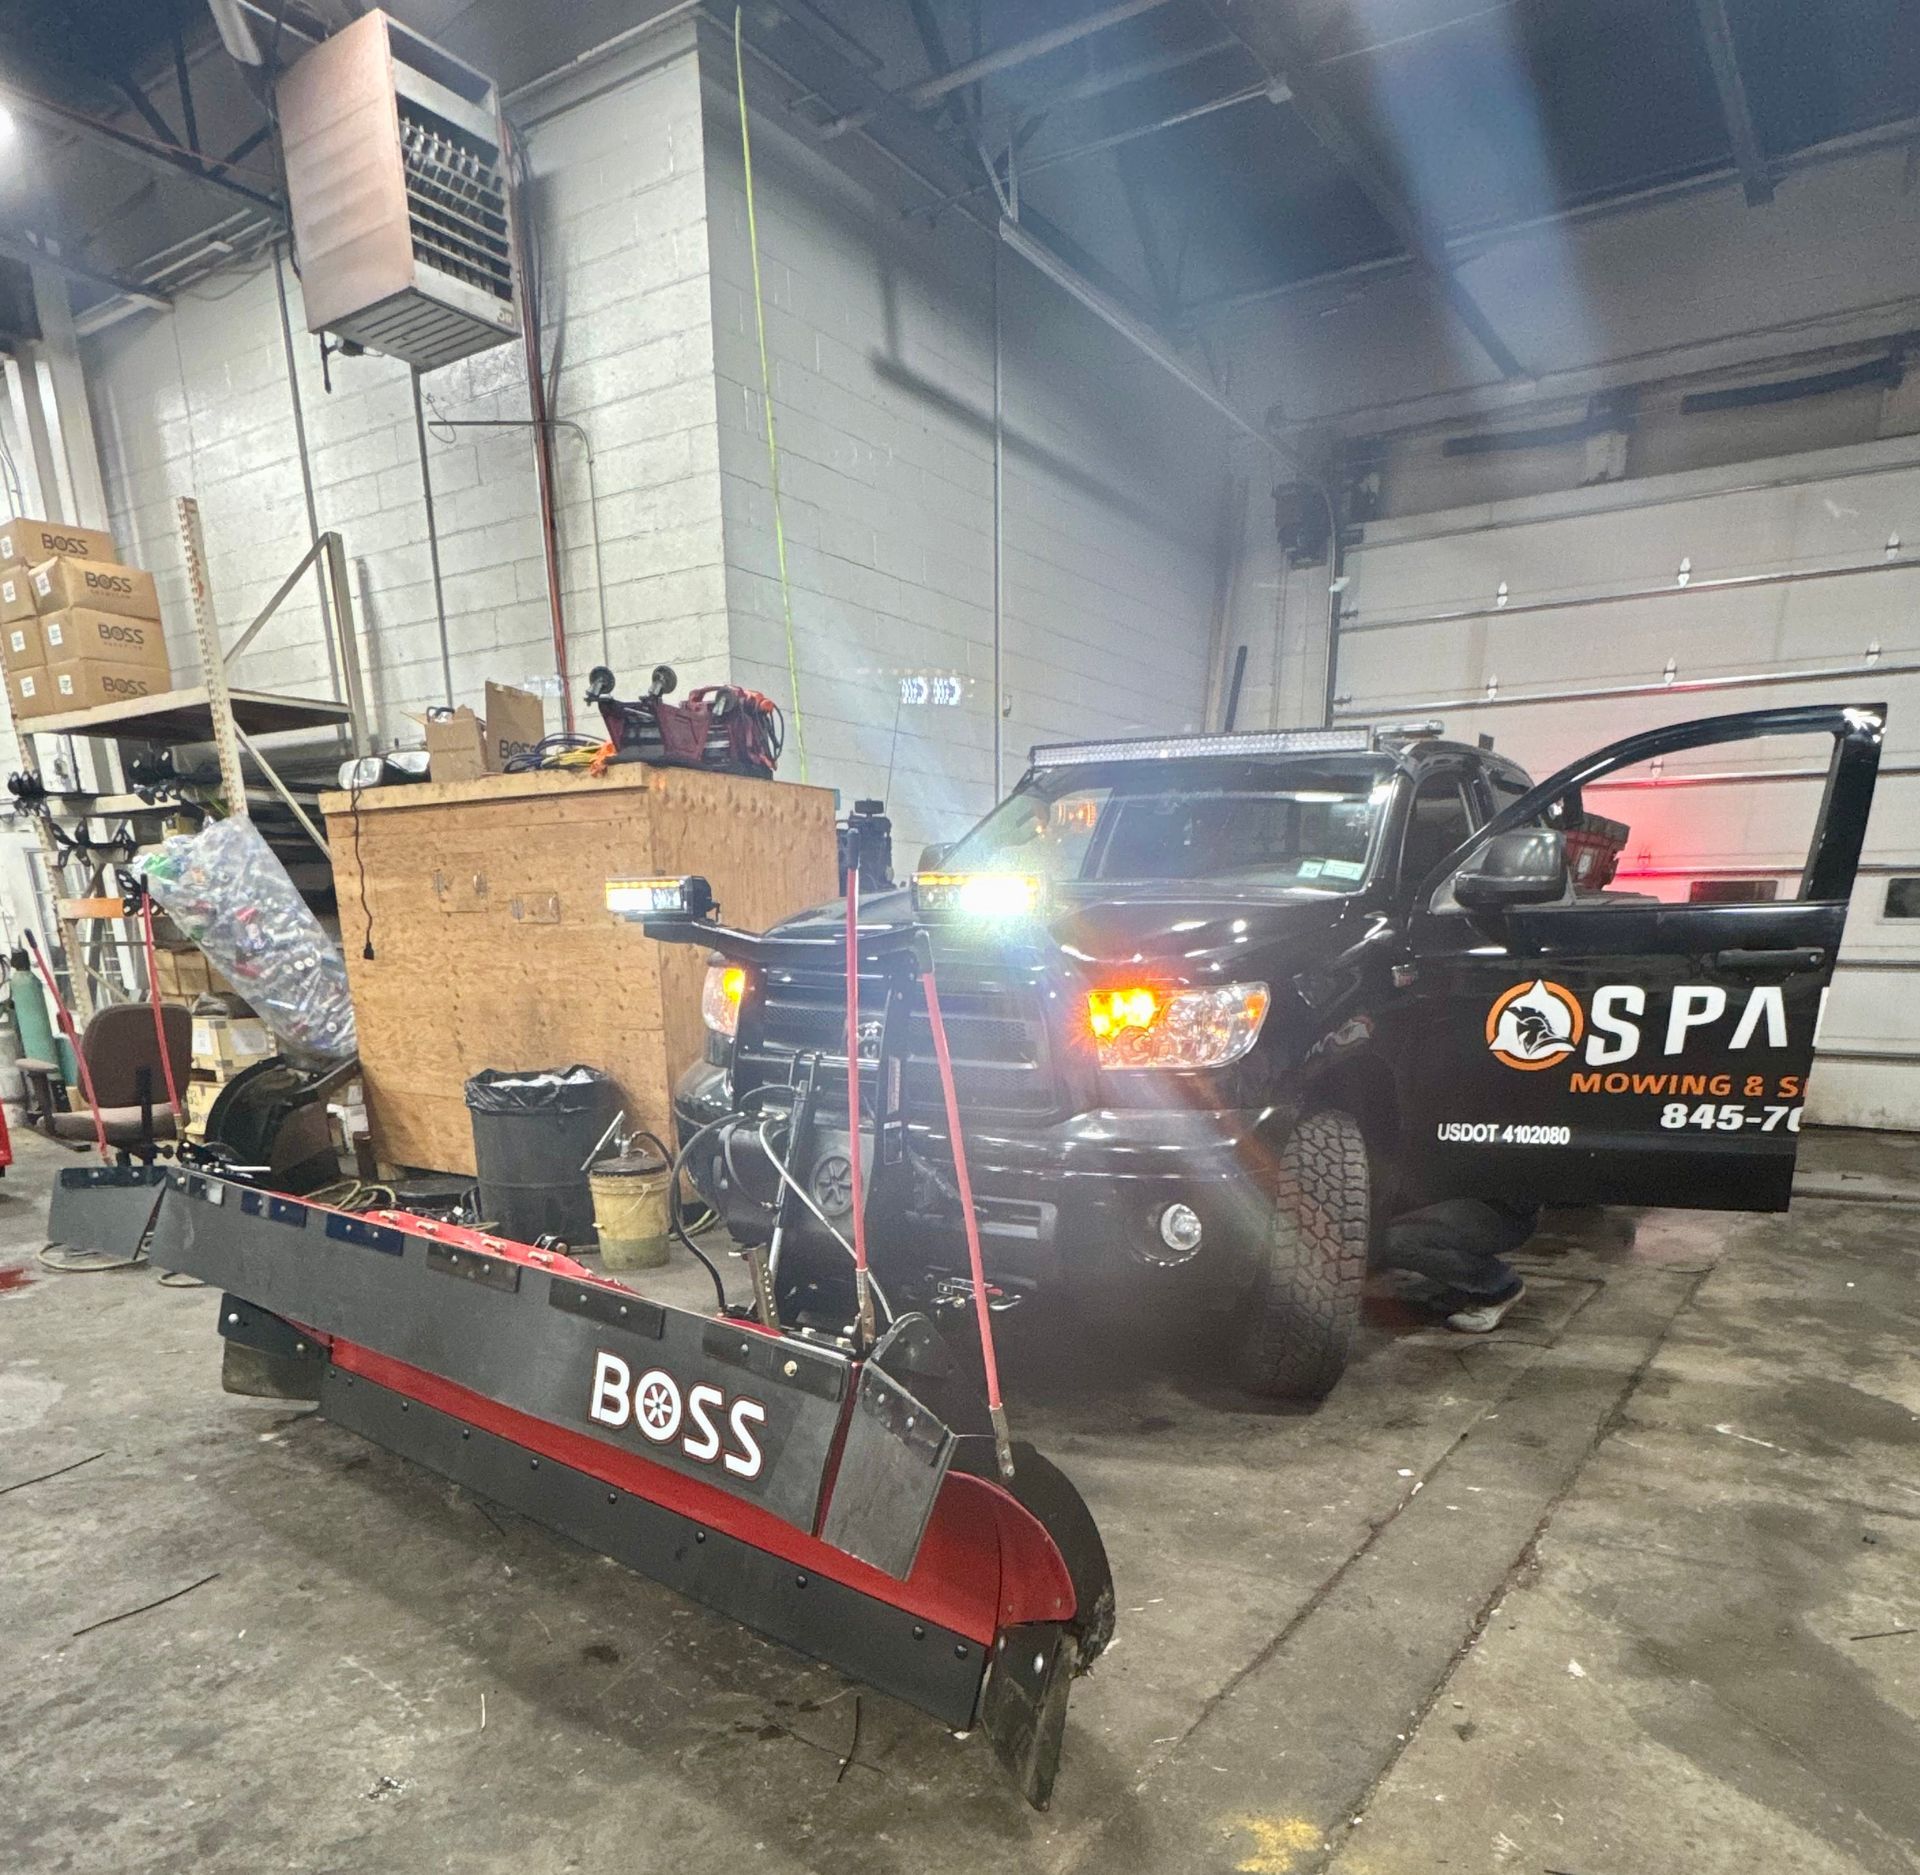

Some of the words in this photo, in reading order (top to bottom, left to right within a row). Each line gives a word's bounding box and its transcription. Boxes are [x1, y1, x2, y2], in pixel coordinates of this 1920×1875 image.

[41, 533, 88, 555] BOSS
[84, 571, 133, 593] BOSS
[98, 624, 145, 645] BOSS
[102, 676, 149, 696] BOSS
[1585, 985, 1830, 1066] SPA
[1569, 1073, 1731, 1097] MOWING
[1743, 1076, 1764, 1097] &
[1437, 1123, 1499, 1142] USDOT
[1502, 1125, 1571, 1145] 4102080
[588, 1349, 767, 1480] BOSS
